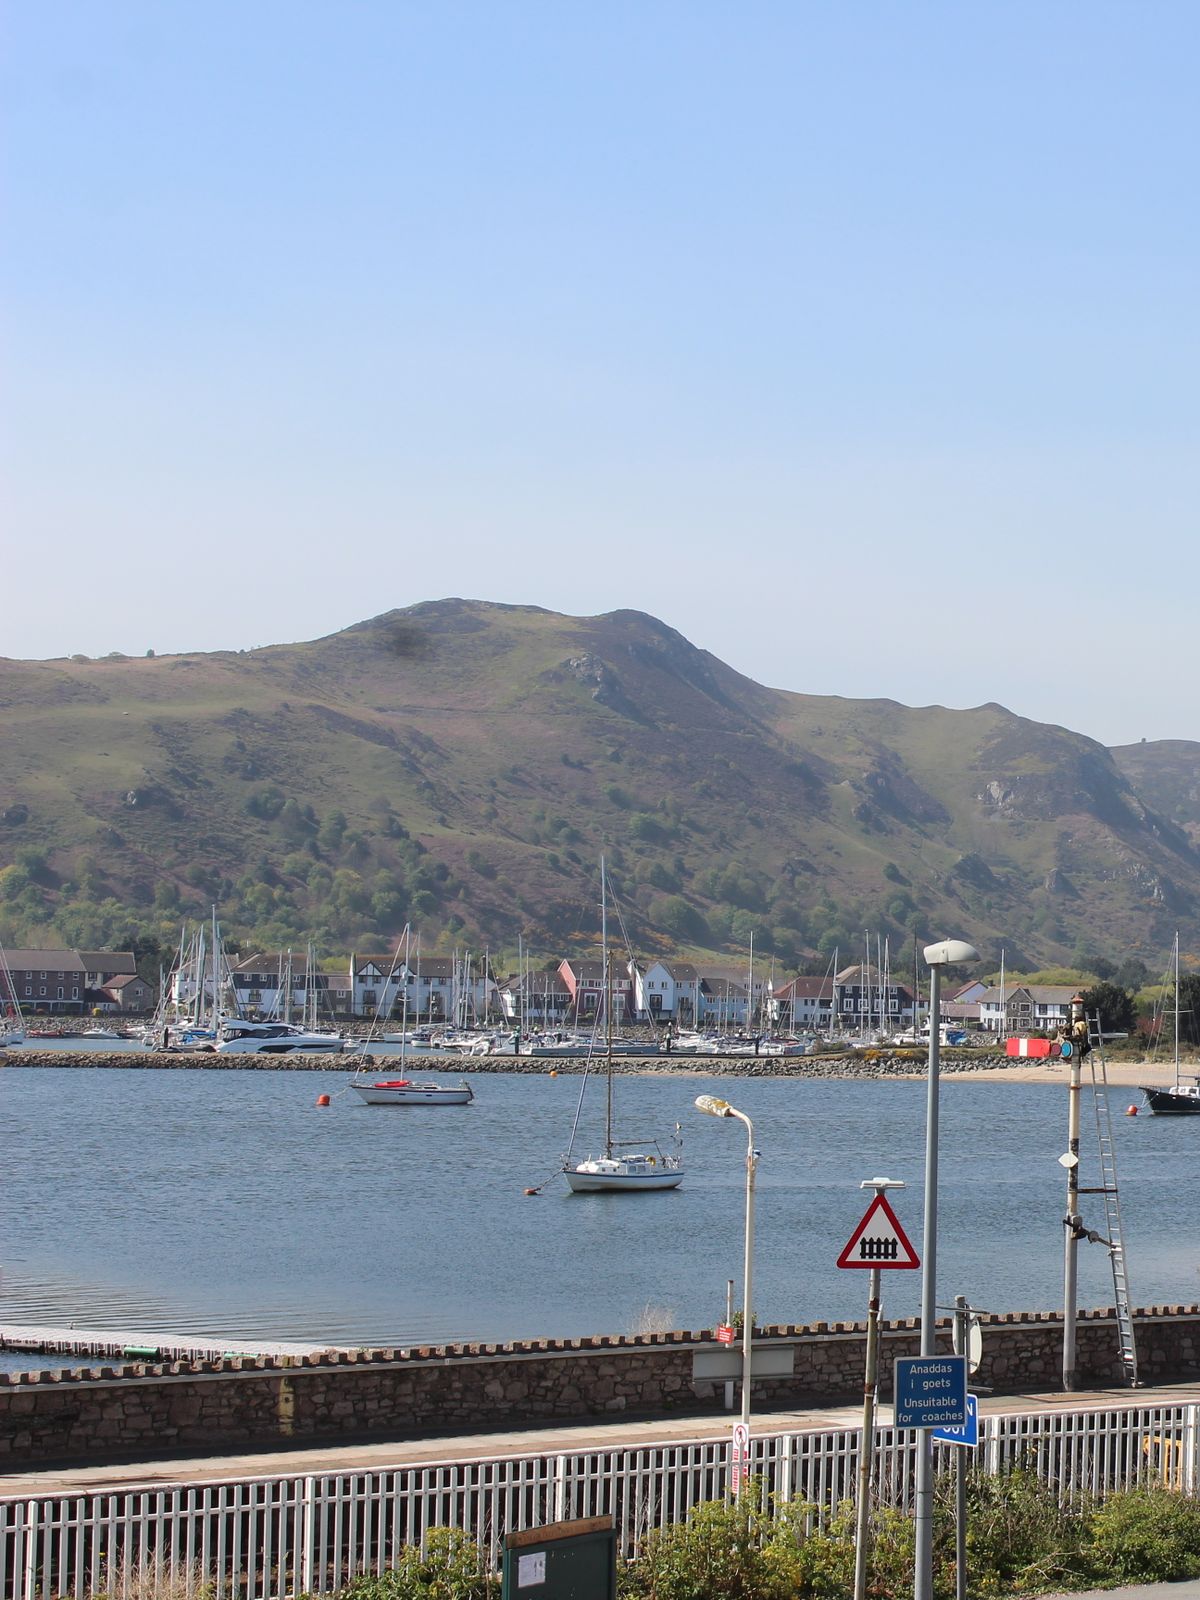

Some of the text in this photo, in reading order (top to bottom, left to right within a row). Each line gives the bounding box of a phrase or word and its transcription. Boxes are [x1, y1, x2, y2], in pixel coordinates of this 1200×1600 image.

[909, 1364, 952, 1374] Anaddas
[922, 1378, 951, 1390] goets
[904, 1396, 957, 1408] Unsuitable
[898, 1411, 964, 1423] for coaches
